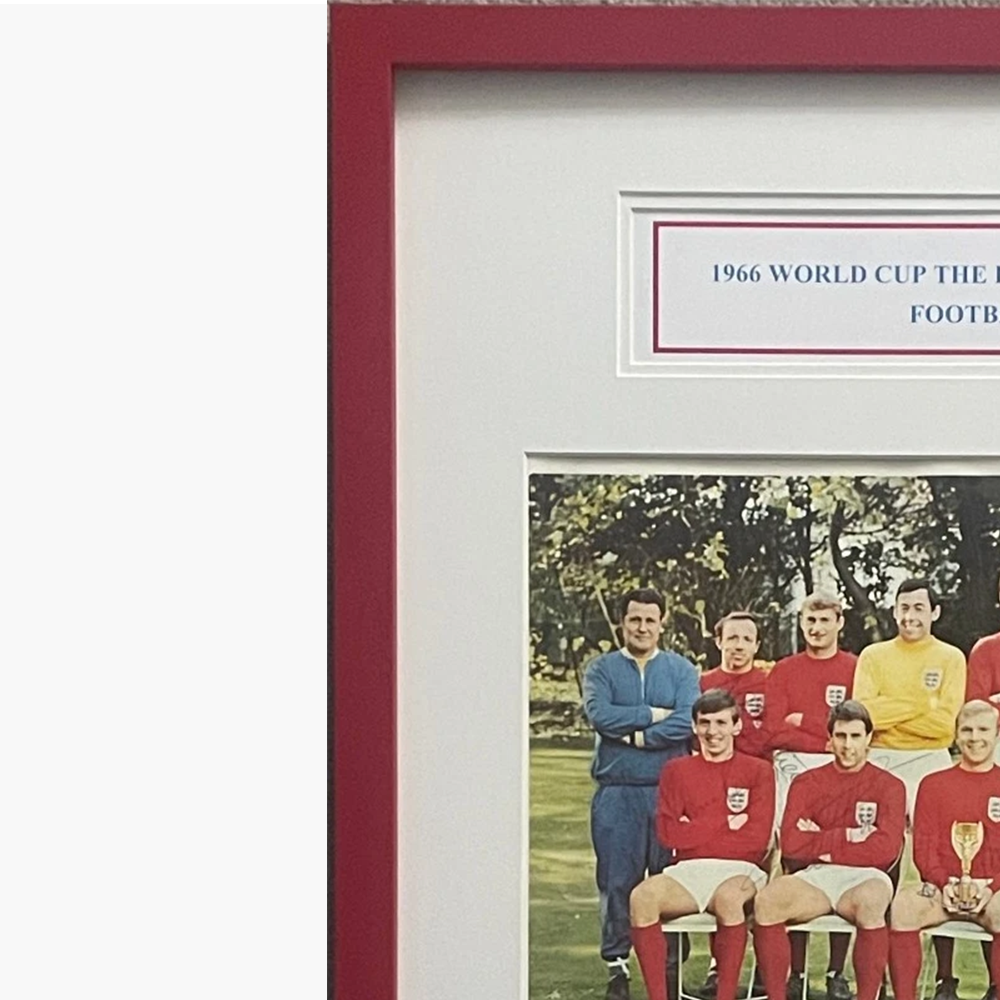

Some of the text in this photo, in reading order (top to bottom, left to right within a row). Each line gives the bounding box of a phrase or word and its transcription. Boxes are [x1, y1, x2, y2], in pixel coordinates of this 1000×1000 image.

[711, 263, 761, 283] 1966
[768, 264, 867, 284] WORLD
[875, 264, 926, 285] CUP
[934, 264, 988, 284] THE
